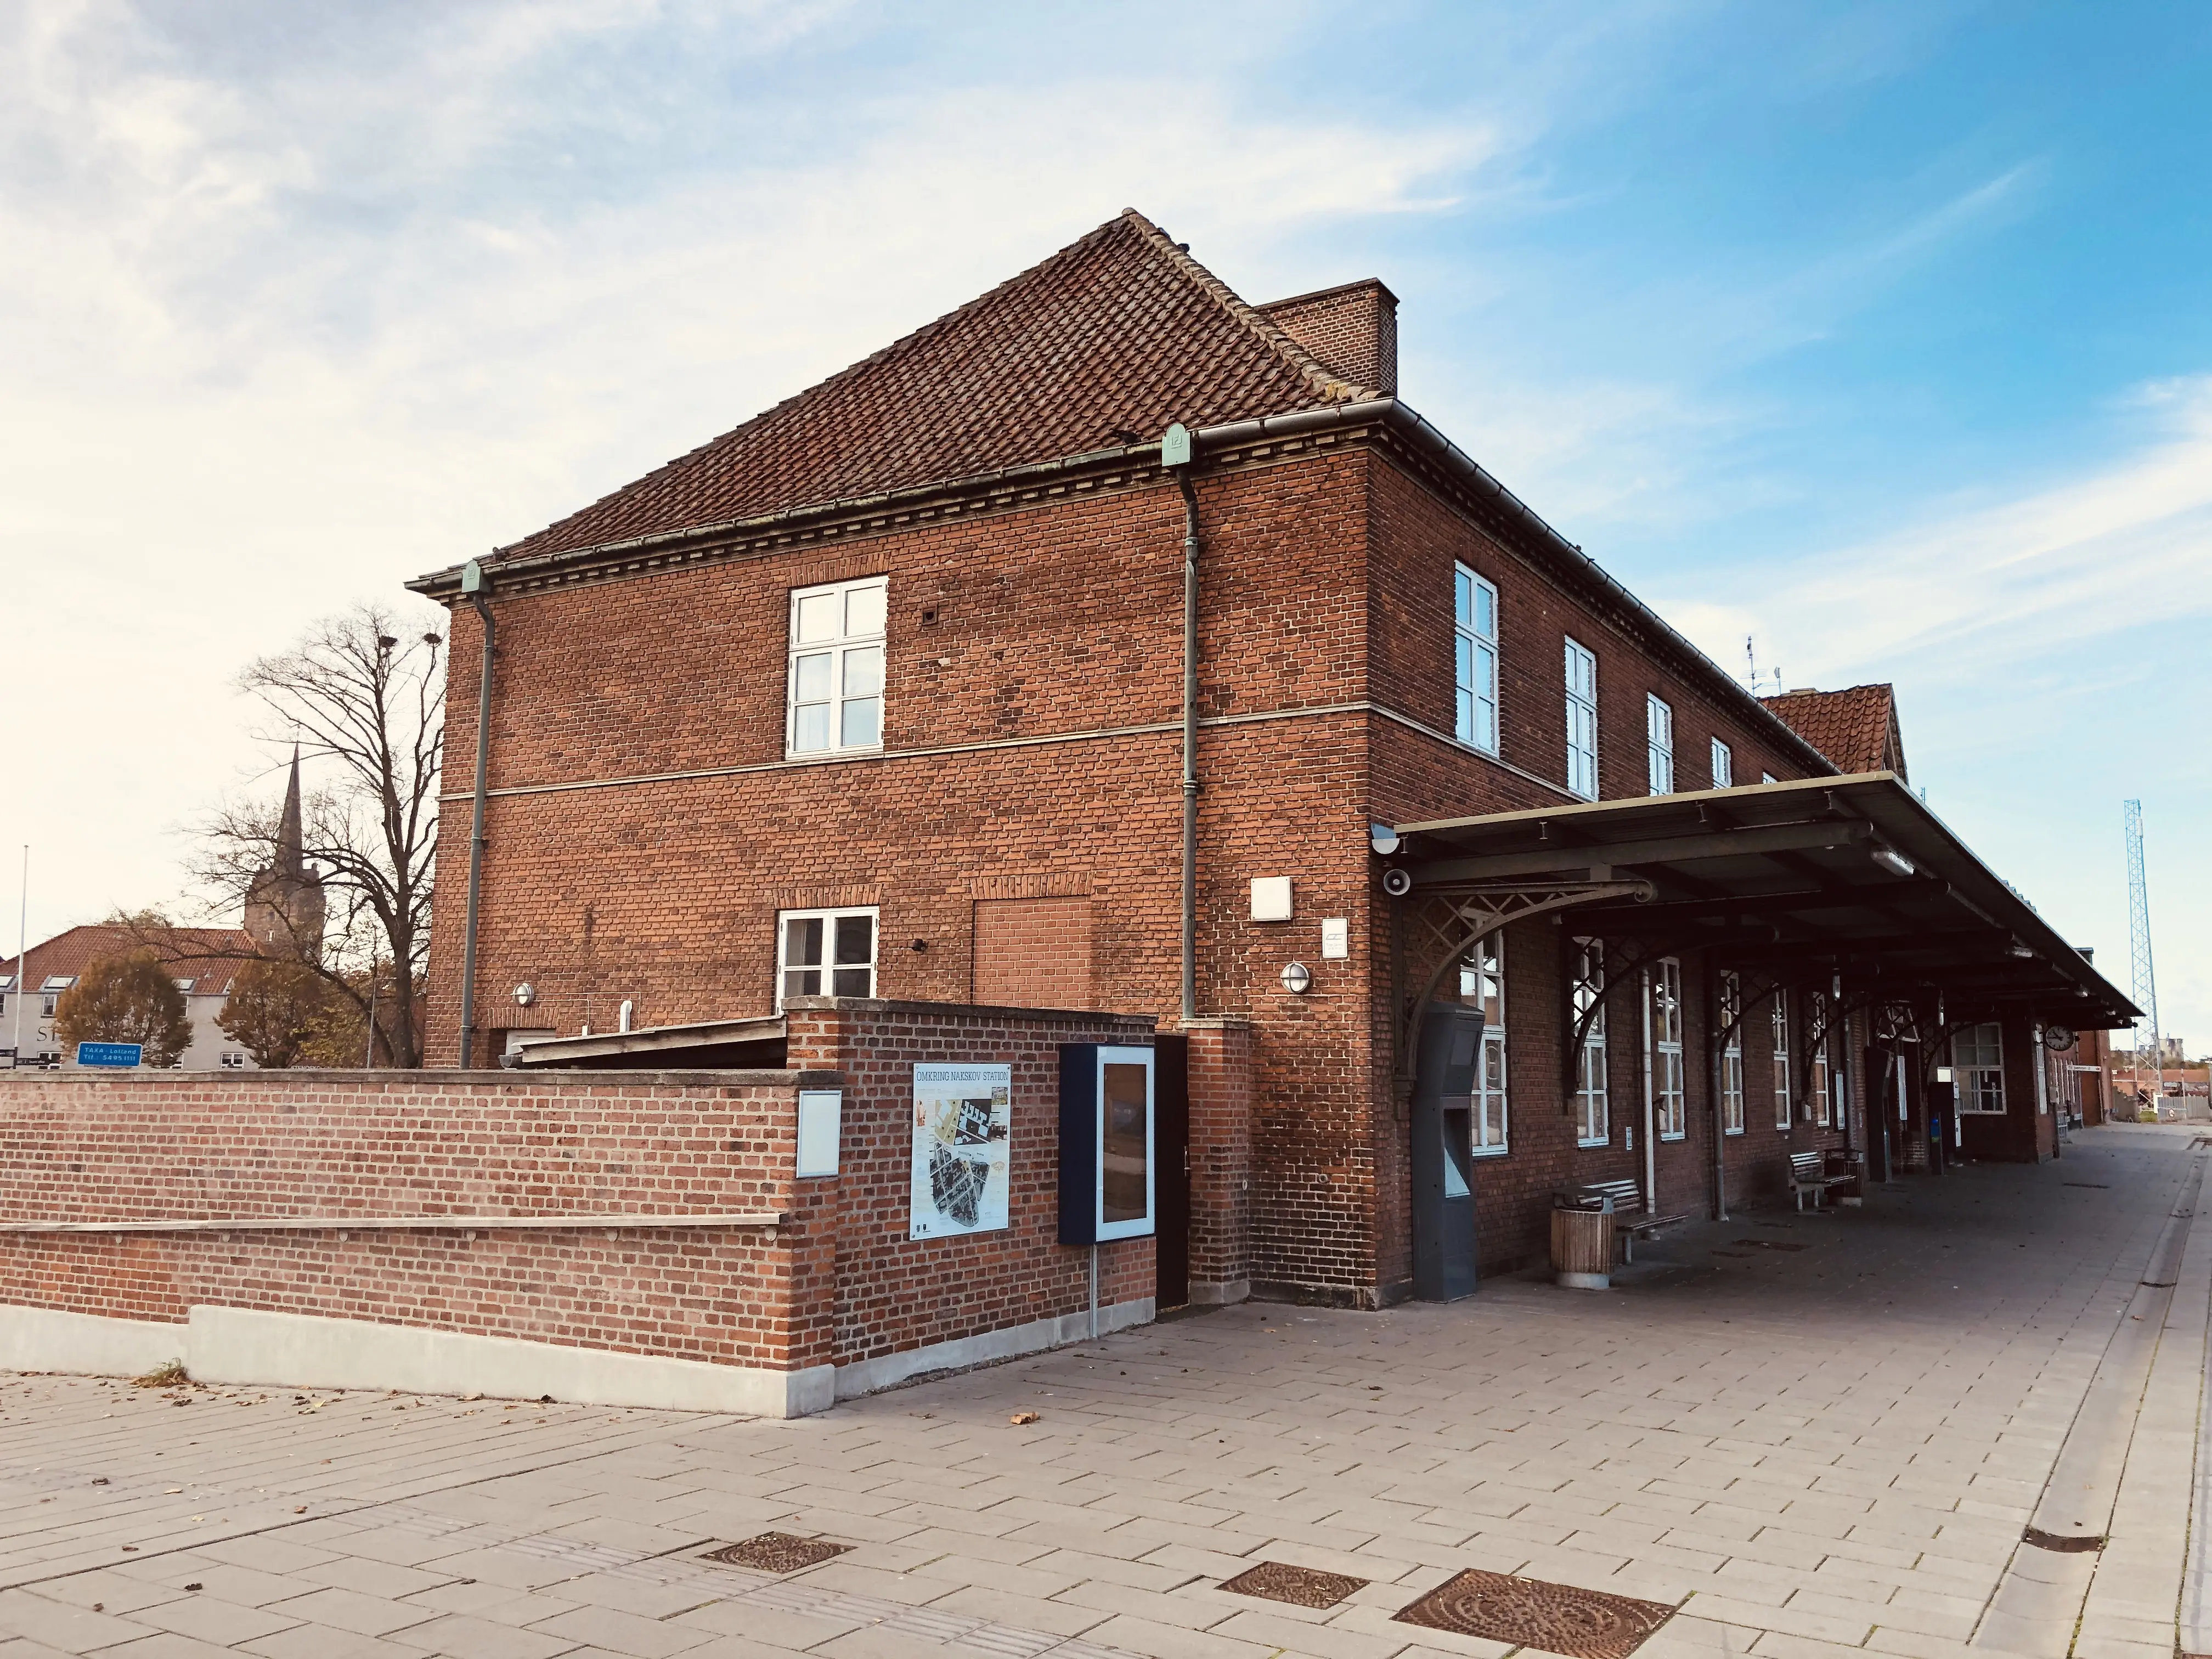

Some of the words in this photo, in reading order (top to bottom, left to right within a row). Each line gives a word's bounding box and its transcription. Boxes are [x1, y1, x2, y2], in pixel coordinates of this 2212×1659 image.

[917, 1071, 950, 1081] OMKRING
[951, 1071, 981, 1081] NAKSKOV
[983, 1071, 1008, 1081] STATION
